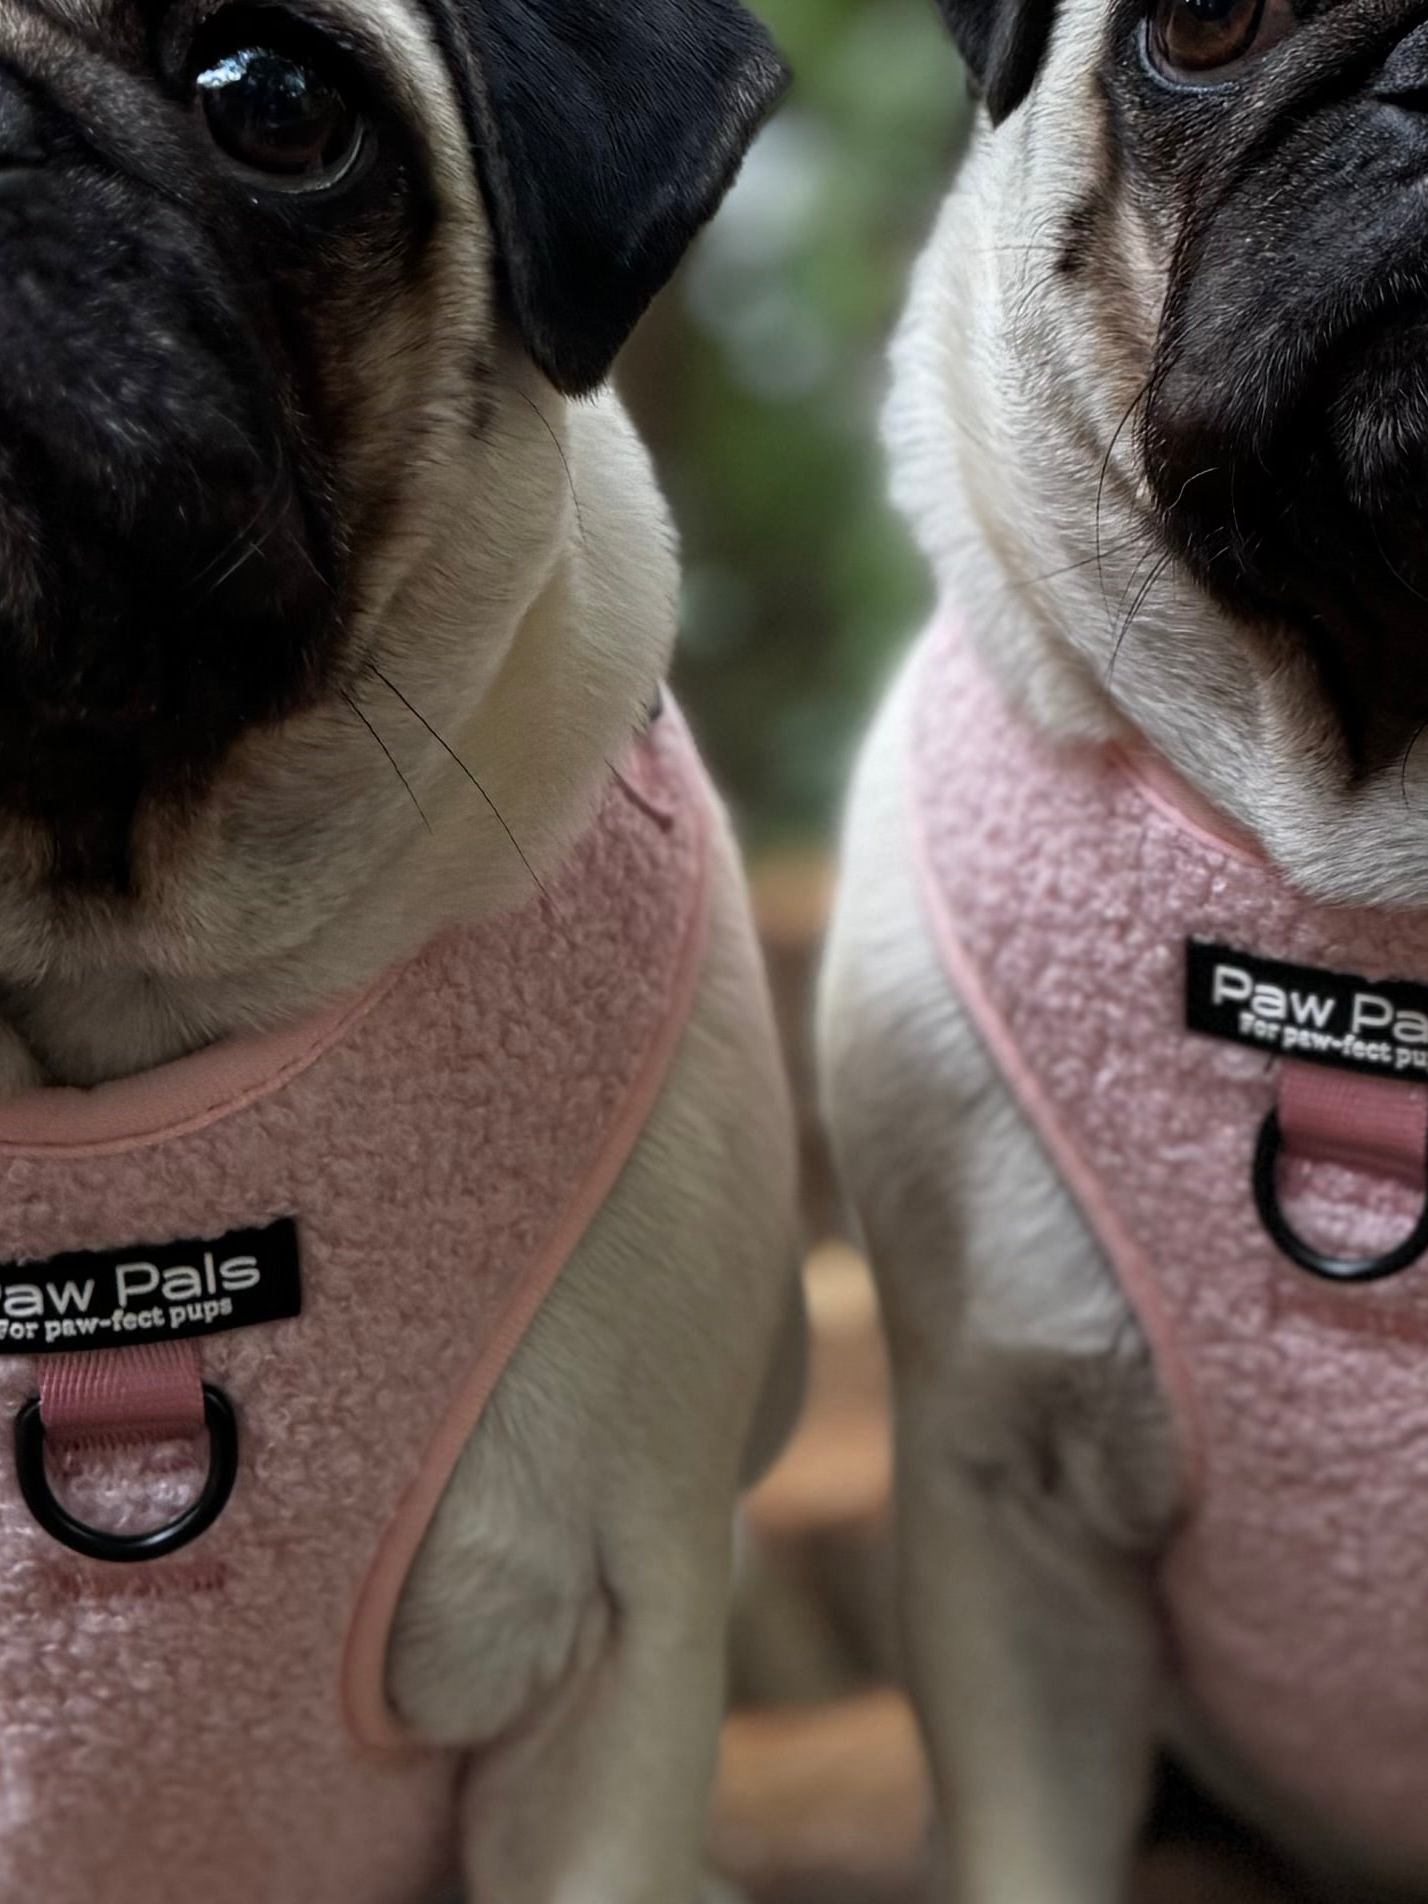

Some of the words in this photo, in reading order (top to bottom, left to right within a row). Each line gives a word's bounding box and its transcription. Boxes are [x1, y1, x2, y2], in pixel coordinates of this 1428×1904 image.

[1212, 964, 1335, 1028] Paw
[1239, 1012, 1279, 1040] For
[1283, 1023, 1392, 1063] paw-fect
[115, 1252, 261, 1308] Pals
[45, 1305, 165, 1343] paw-fect
[169, 1296, 233, 1330] pups
